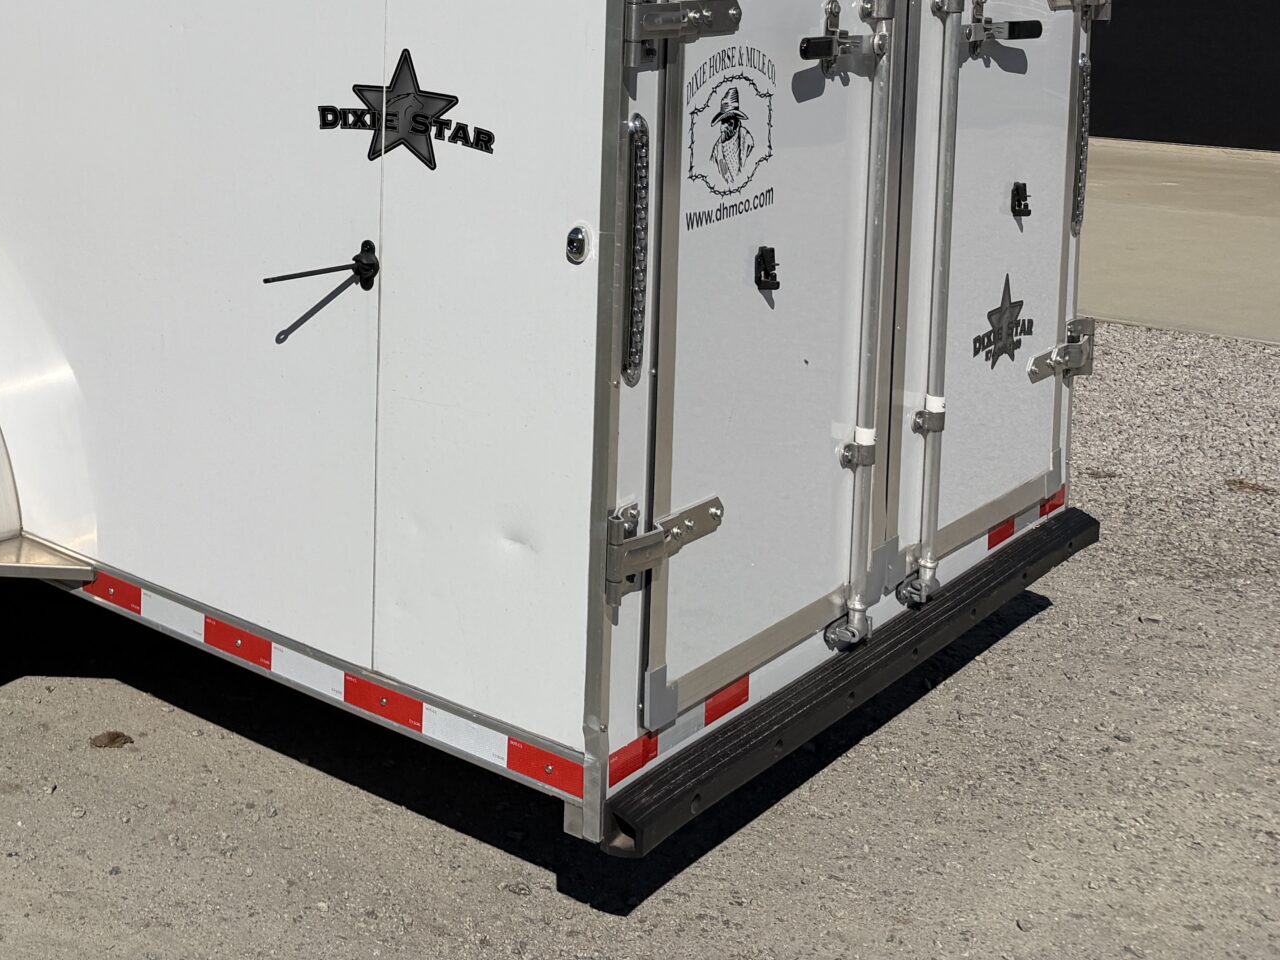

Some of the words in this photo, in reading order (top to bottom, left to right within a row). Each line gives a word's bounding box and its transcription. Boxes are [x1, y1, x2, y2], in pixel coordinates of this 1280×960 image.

[686, 62, 707, 107] DIXIE
[708, 46, 737, 79] HORSE
[738, 46, 744, 67] &
[745, 46, 767, 76] MULE
[318, 105, 400, 133] DIXIE
[409, 112, 496, 154] STAR
[685, 186, 774, 232] www.dhmco.com
[1007, 318, 1034, 338] STAR
